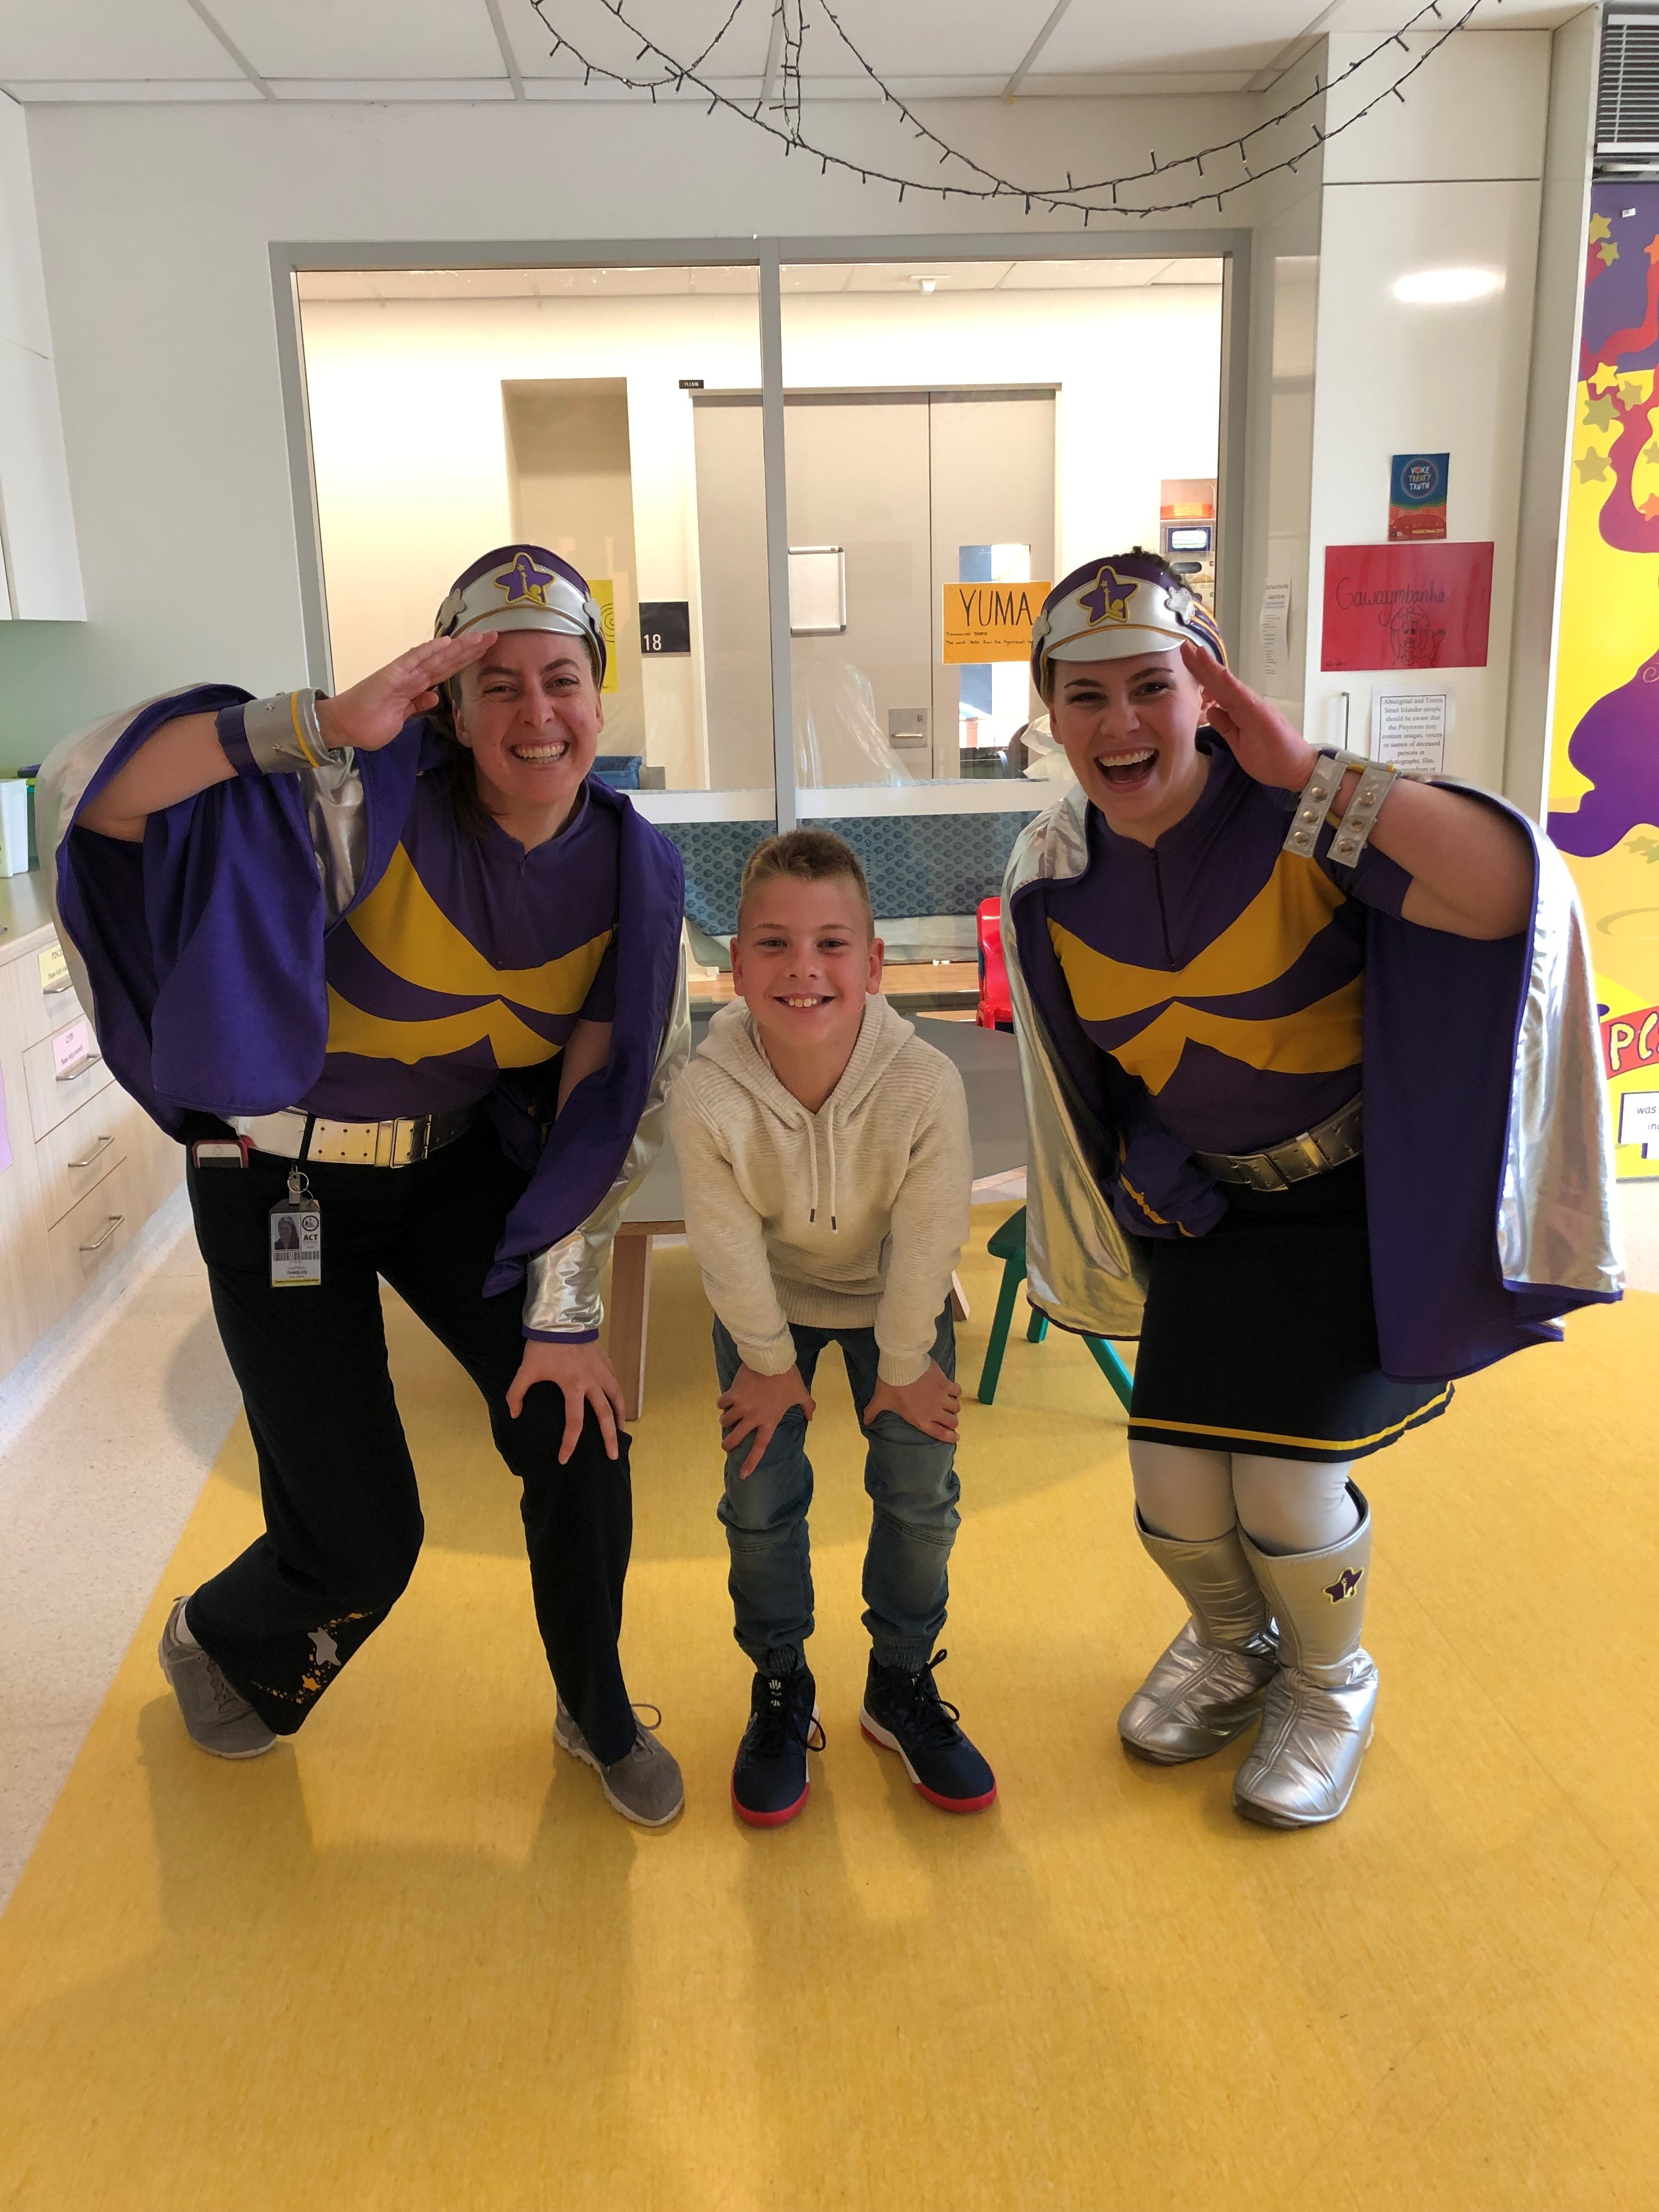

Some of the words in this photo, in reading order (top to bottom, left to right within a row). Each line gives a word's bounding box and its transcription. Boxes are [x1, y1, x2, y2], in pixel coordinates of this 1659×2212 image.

[1408, 474, 1431, 483] TREATY
[959, 589, 1033, 627] YUMA
[643, 634, 662, 651] 18
[1637, 1106, 1656, 1114] was
